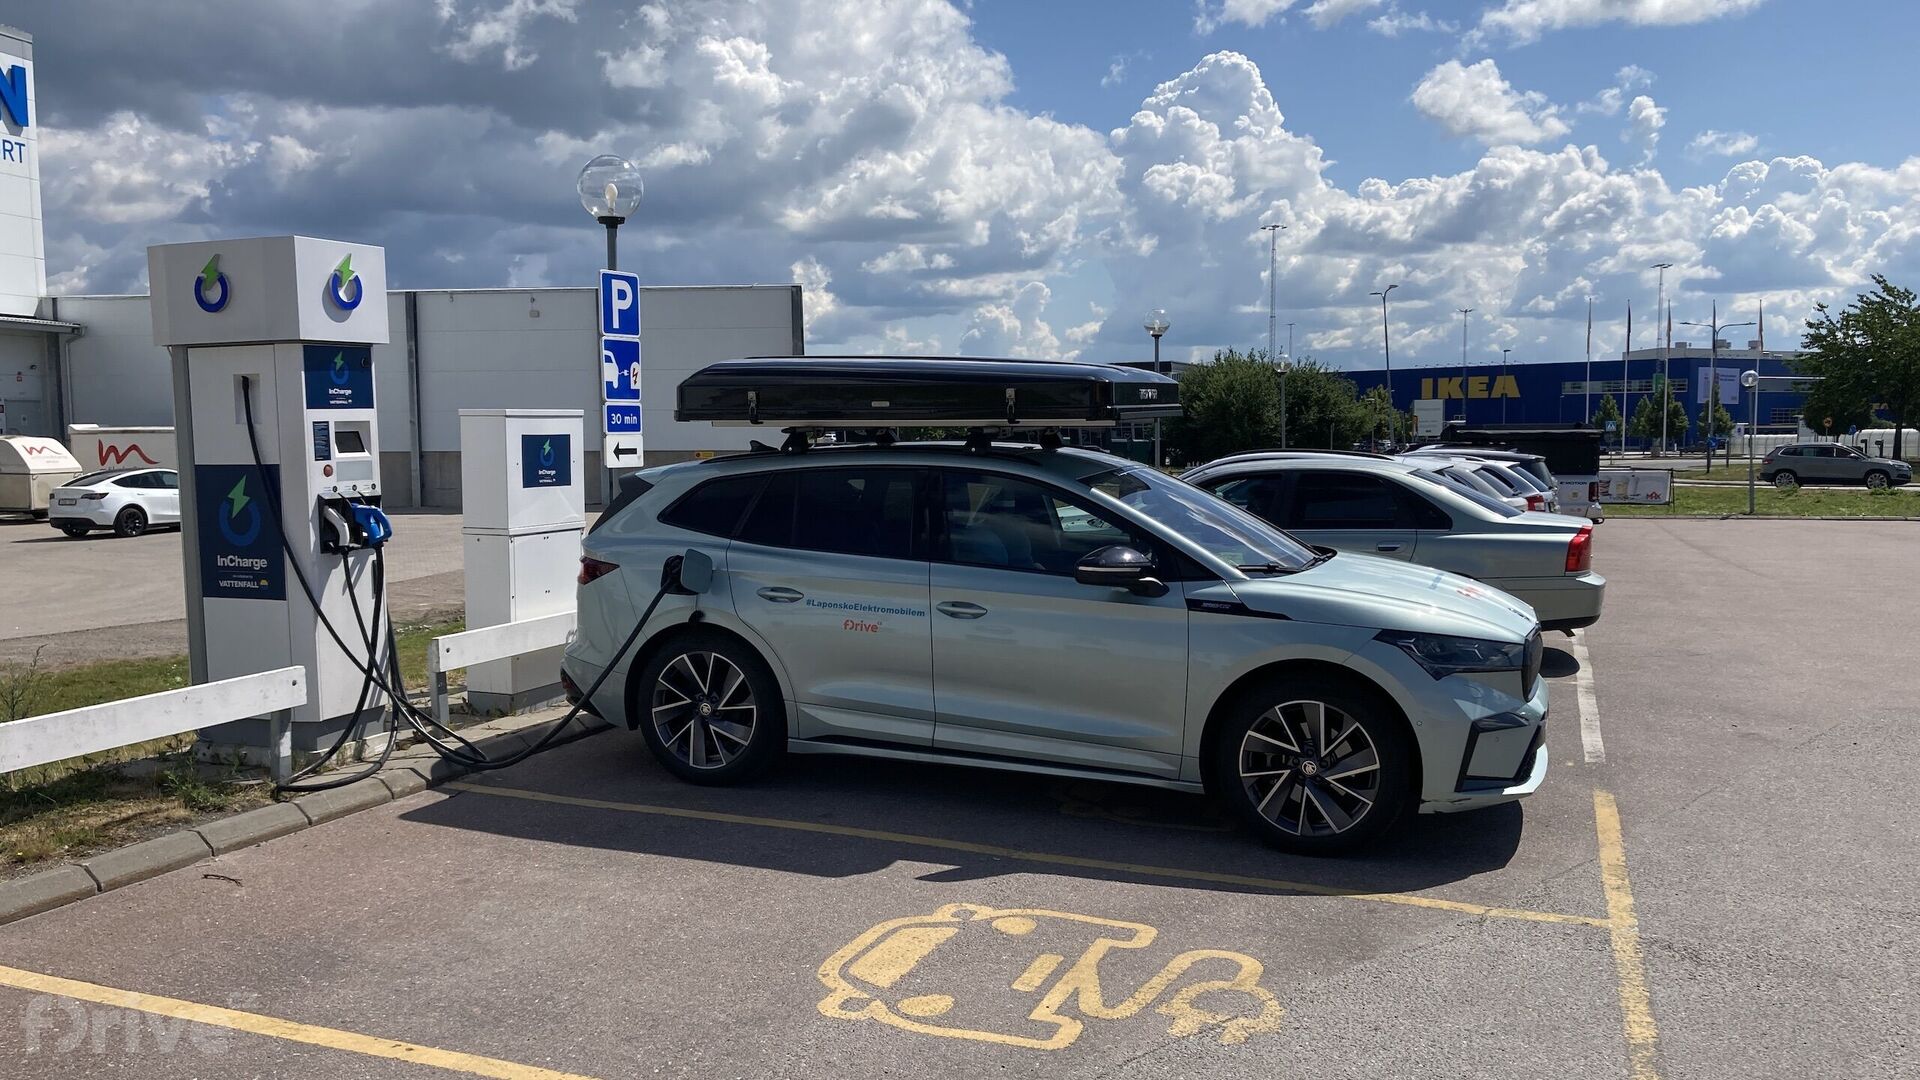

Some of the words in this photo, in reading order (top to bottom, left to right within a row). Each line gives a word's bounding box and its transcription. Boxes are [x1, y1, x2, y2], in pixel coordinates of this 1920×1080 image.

[611, 279, 633, 329] P
[1421, 375, 1521, 400] IKEA
[611, 413, 621, 425] 30
[624, 413, 638, 426] min
[217, 555, 268, 570] InCharge
[218, 580, 259, 588] VATTENFALL
[806, 599, 926, 617] #LaponskoElektromobilem
